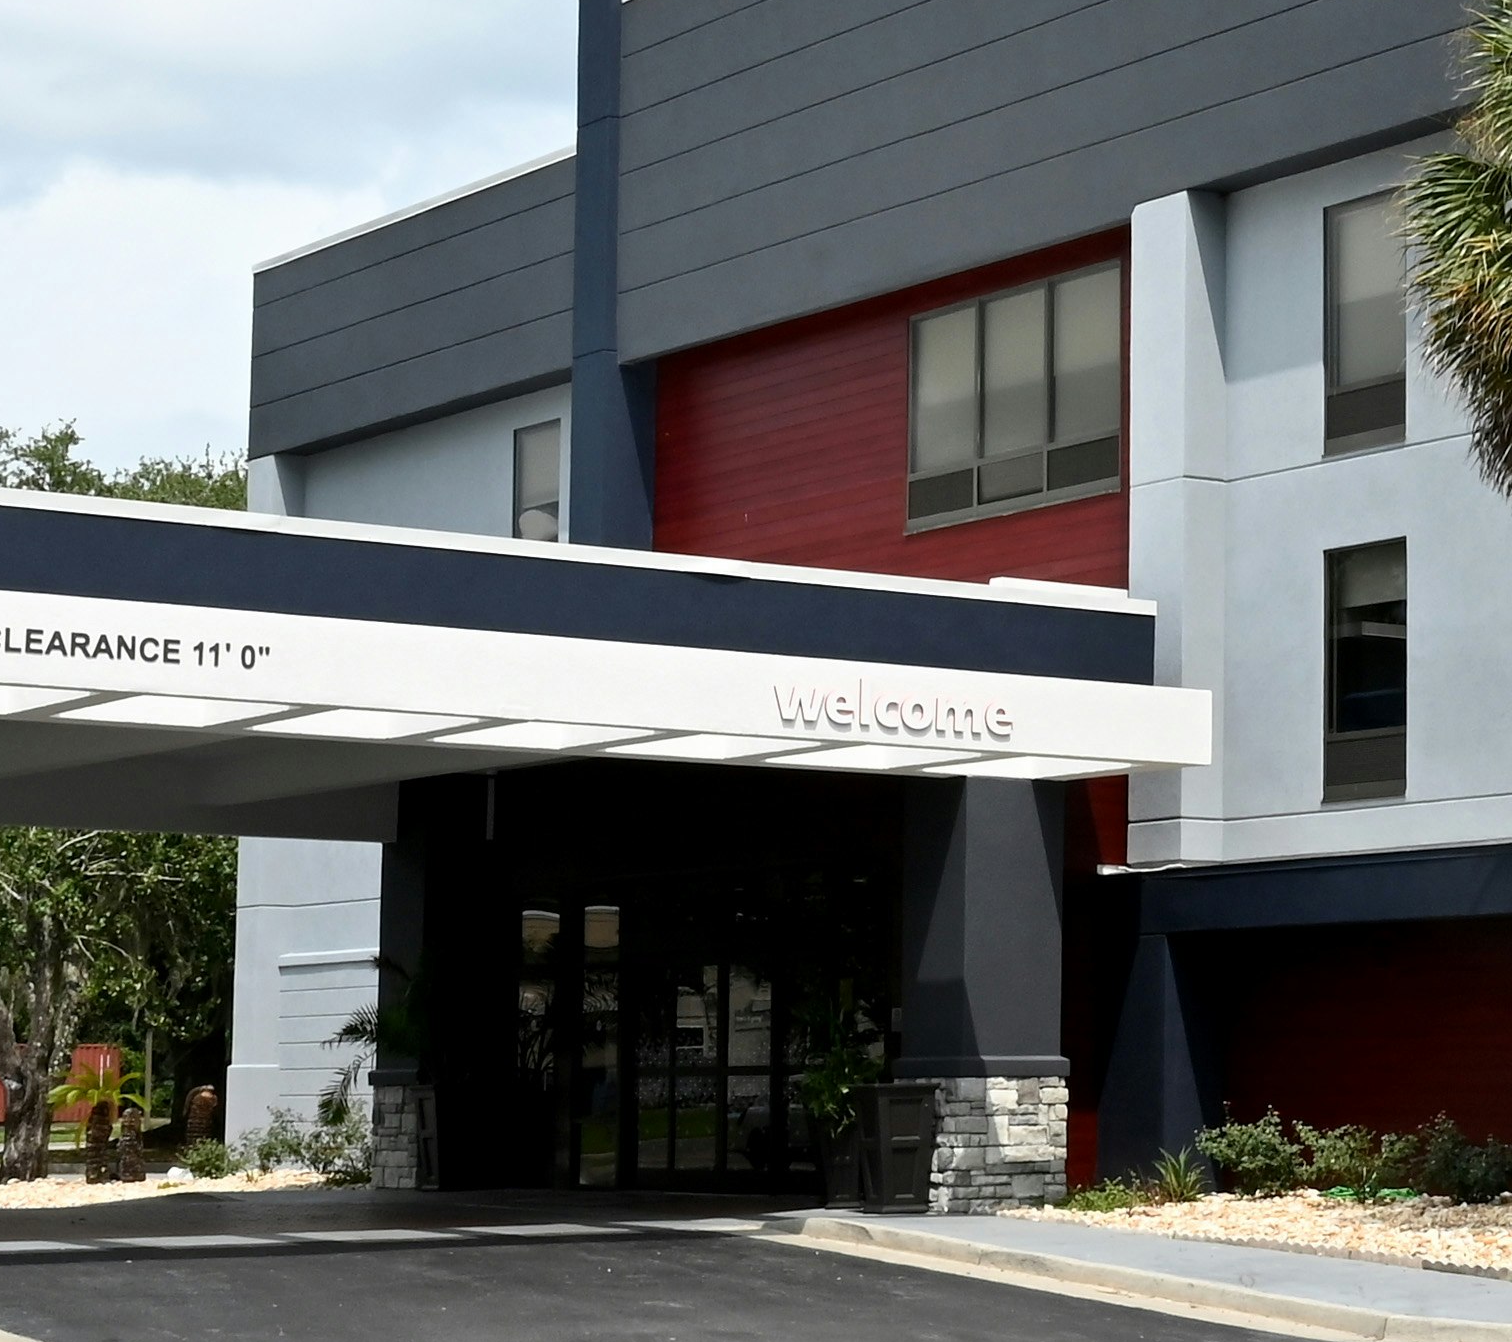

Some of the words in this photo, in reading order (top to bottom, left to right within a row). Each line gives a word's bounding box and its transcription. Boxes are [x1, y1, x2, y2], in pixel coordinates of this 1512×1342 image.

[193, 640, 232, 668] 11'
[240, 644, 271, 670] 0"
[773, 677, 1014, 739] welcome
